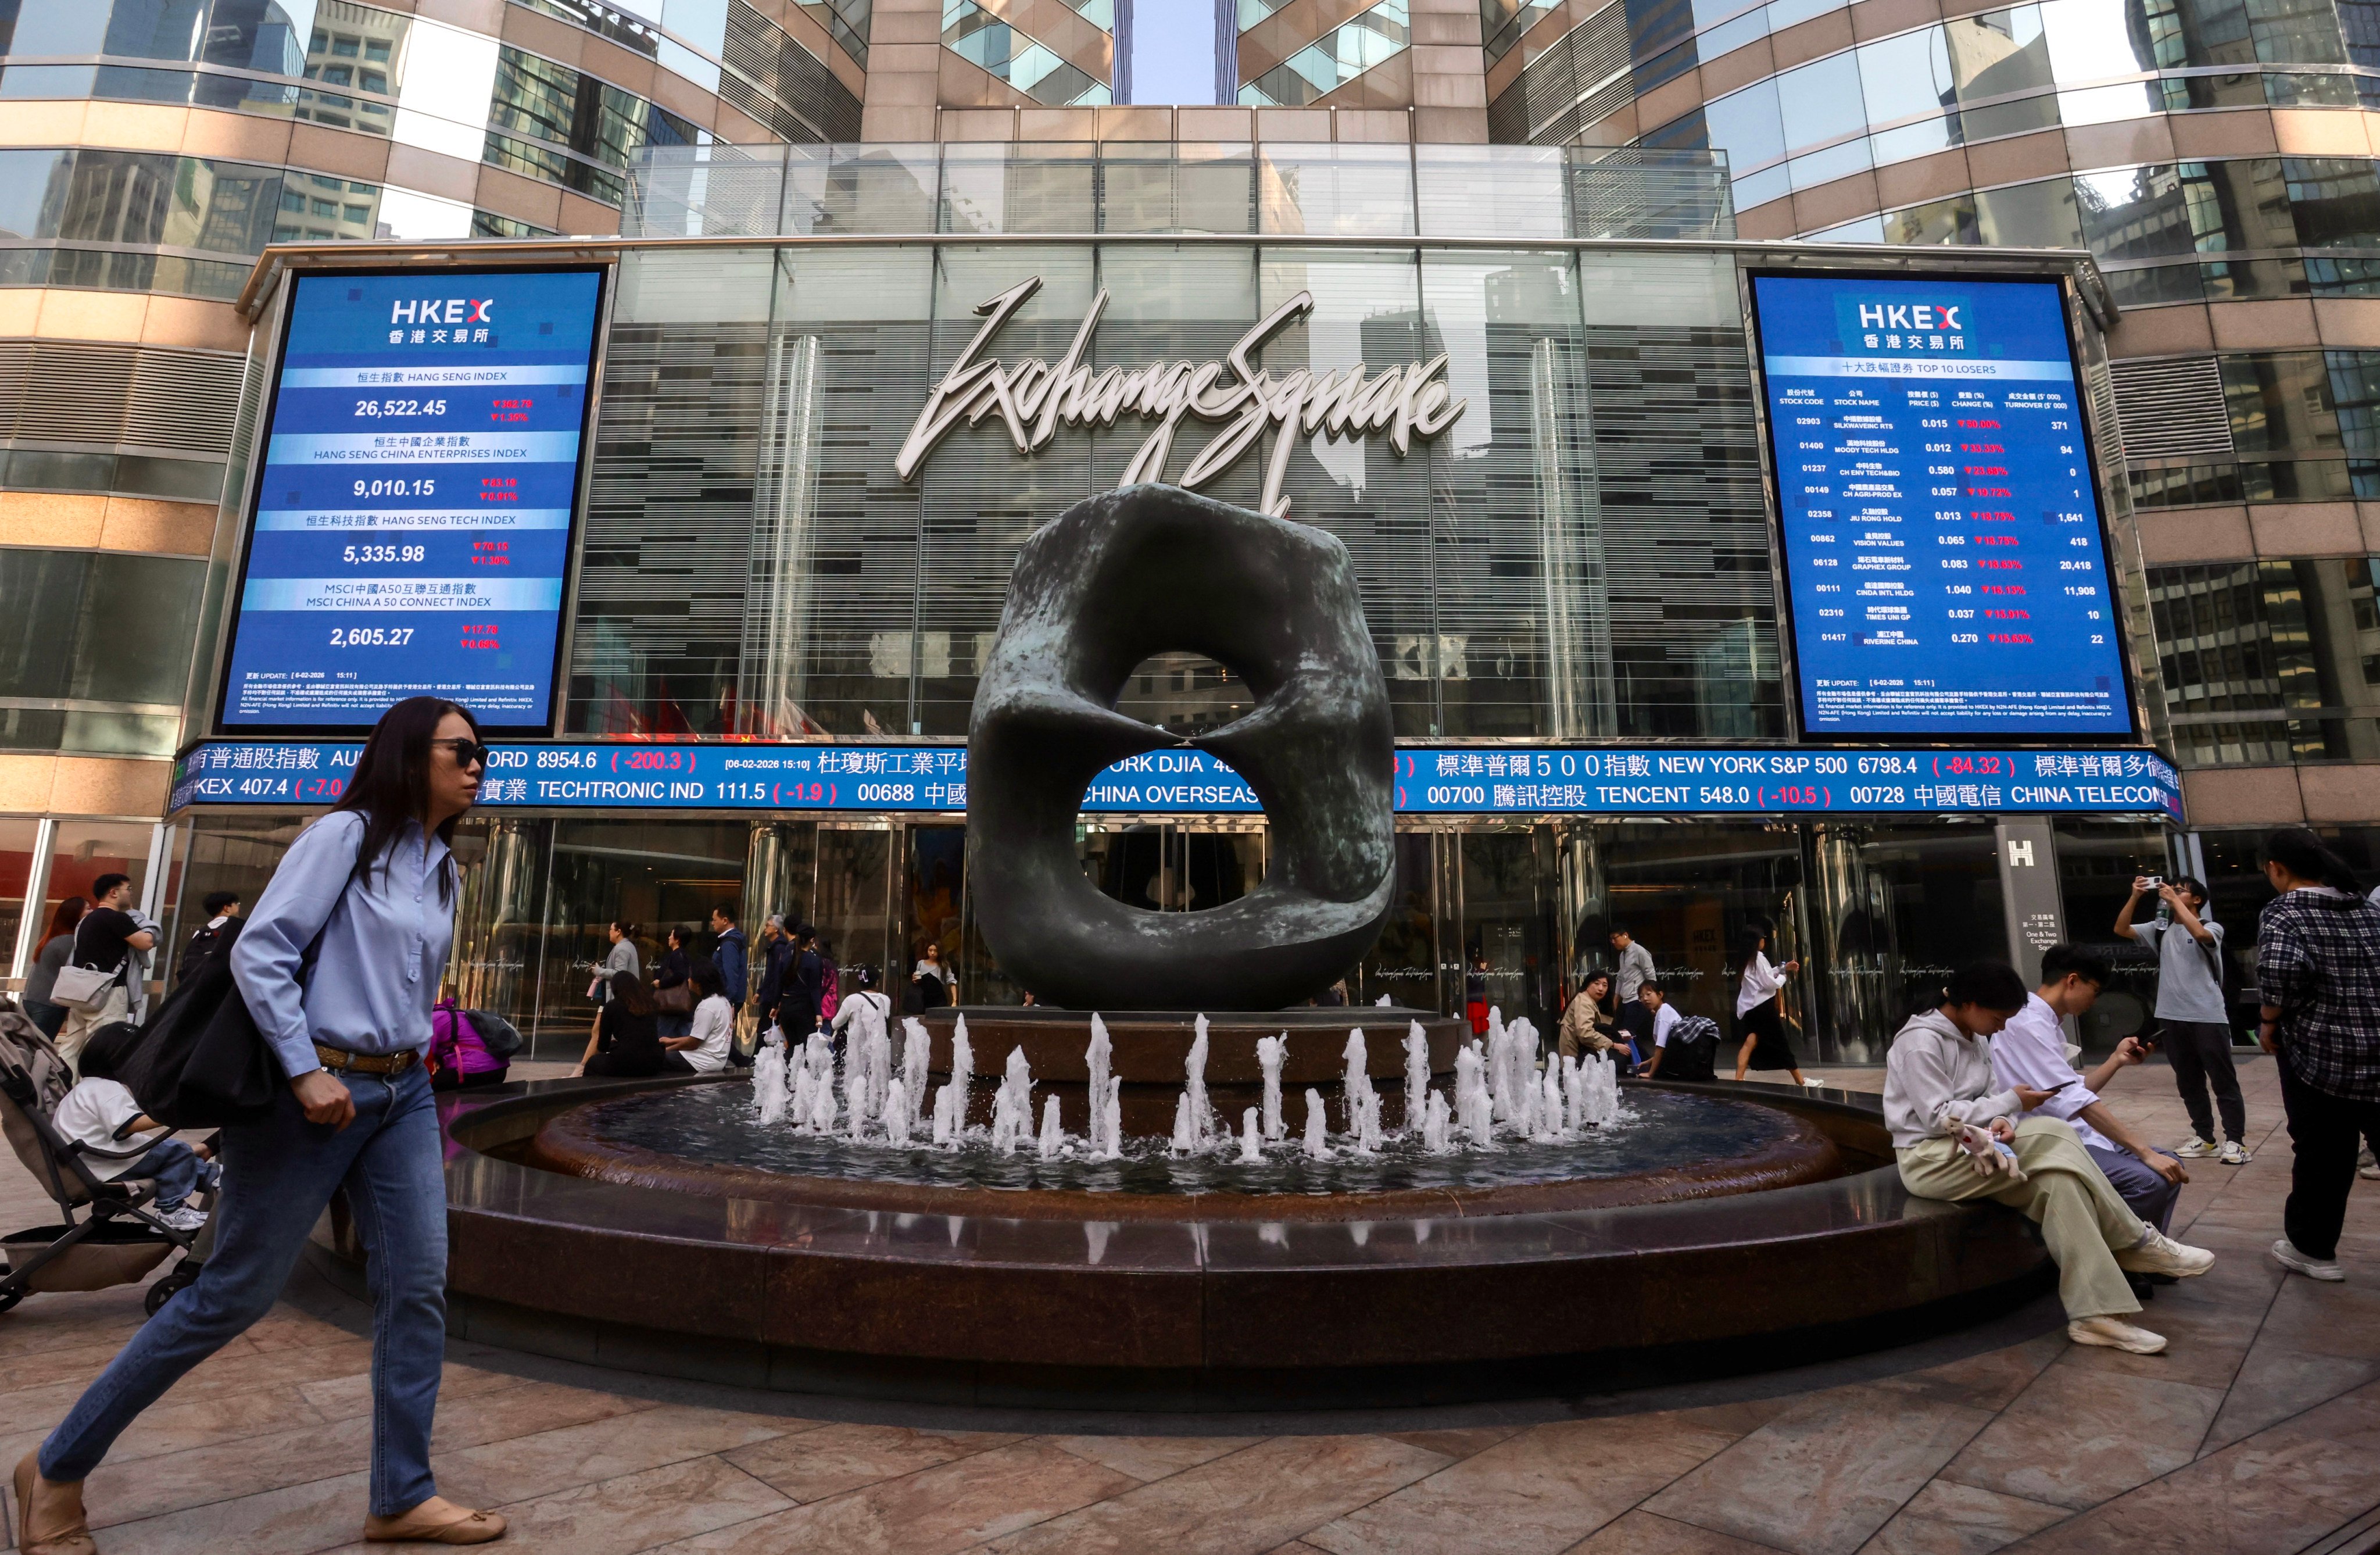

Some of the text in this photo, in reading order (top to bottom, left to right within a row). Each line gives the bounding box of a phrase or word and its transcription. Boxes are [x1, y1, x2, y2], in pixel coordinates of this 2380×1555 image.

[392, 299, 493, 323] HKEX
[1860, 305, 1961, 329] HKEX
[389, 329, 489, 344] 香港交易所
[1864, 334, 1964, 349] 香港交易所
[1841, 361, 1996, 374] 十大跌幅證券 TOP 10 LOSERS
[357, 371, 507, 383] 恒生指數 HANG SENG INDEX
[895, 275, 1468, 517] Exchange Square
[355, 400, 446, 418] 26,522.45
[1921, 419, 1948, 428] 0.015
[2050, 421, 2068, 430] 371
[374, 435, 470, 448] 恒生中國企業指數
[1925, 443, 1952, 452] 0.012
[2060, 445, 2073, 454] 94
[314, 449, 528, 459] HANG SENG CHINA ENTERPRISES INDEX
[1928, 466, 1955, 475] 0.580
[2070, 468, 2077, 477] 0
[354, 480, 434, 498] 9,010.15
[1931, 487, 1957, 496] 0.057
[2073, 489, 2079, 498] 1
[305, 514, 517, 527] 恒生科技指數 HANG SENG TECH INDEX
[1808, 510, 1833, 518] 02358
[1935, 511, 1962, 520] 0.013
[2057, 513, 2083, 523] 1,641
[1938, 535, 1965, 545] 0.065
[2070, 537, 2088, 546] 418
[343, 546, 424, 564] 5,335.98
[1941, 559, 1968, 569] 0.083
[2059, 560, 2092, 571] 20,418
[1816, 584, 1840, 592] 00111
[1945, 585, 1971, 594] 1.040
[2064, 586, 2096, 596] 11,908
[306, 598, 492, 607] MSCI CHINA A 50 CONNECT INDEX
[1819, 609, 1844, 617] 02310
[1948, 609, 1974, 619] 0.037
[2087, 610, 2099, 620] 10
[330, 628, 414, 648] 2,605.27
[1821, 633, 1846, 641] 01417
[1951, 634, 1978, 643] 0.270
[2091, 634, 2103, 644] 22
[330, 750, 363, 766] AU
[537, 752, 596, 768] 8954.6
[1103, 756, 1203, 772] ORK DJIA
[1659, 757, 1704, 773] NEW
[1709, 757, 1766, 773] YORK
[1771, 757, 1809, 773] S&P
[1816, 757, 1847, 773] 500
[1859, 757, 1917, 773] 6798.4
[240, 778, 287, 795] 407.4
[538, 781, 664, 798] TECHTRONIC
[671, 783, 703, 798] IND
[717, 782, 765, 799] 111.5
[858, 784, 914, 801] 00688
[1428, 787, 1484, 803] 00700
[1494, 784, 1587, 807] 騰訊控股
[1596, 787, 1690, 803] TENCENT
[1701, 787, 1749, 803] 548.0
[1851, 787, 1905, 803] 00728
[1914, 784, 2000, 806] 中國電信
[2012, 787, 2072, 803] CHINA
